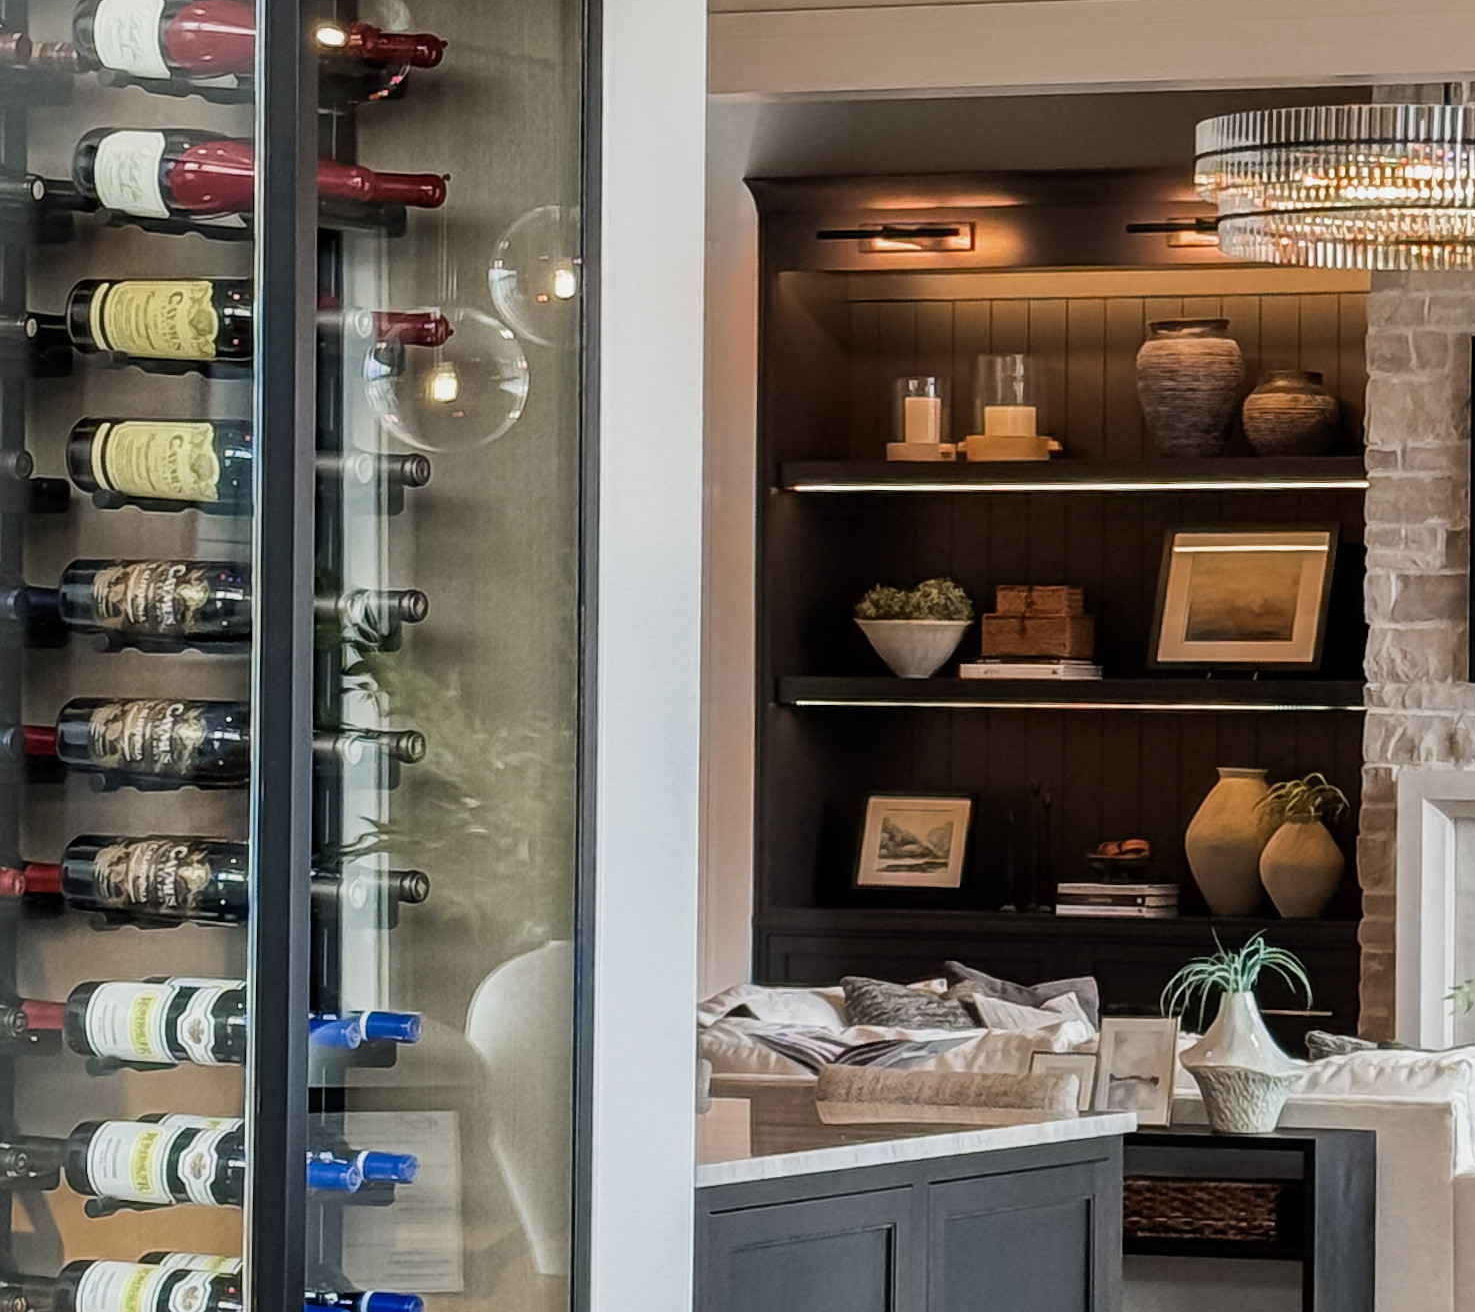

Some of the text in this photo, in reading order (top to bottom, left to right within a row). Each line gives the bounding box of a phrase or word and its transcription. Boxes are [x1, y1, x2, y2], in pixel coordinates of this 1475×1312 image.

[161, 564, 187, 625] CAYMUS
[158, 703, 184, 765] CAYMUS
[163, 845, 188, 907] CAYMUS
